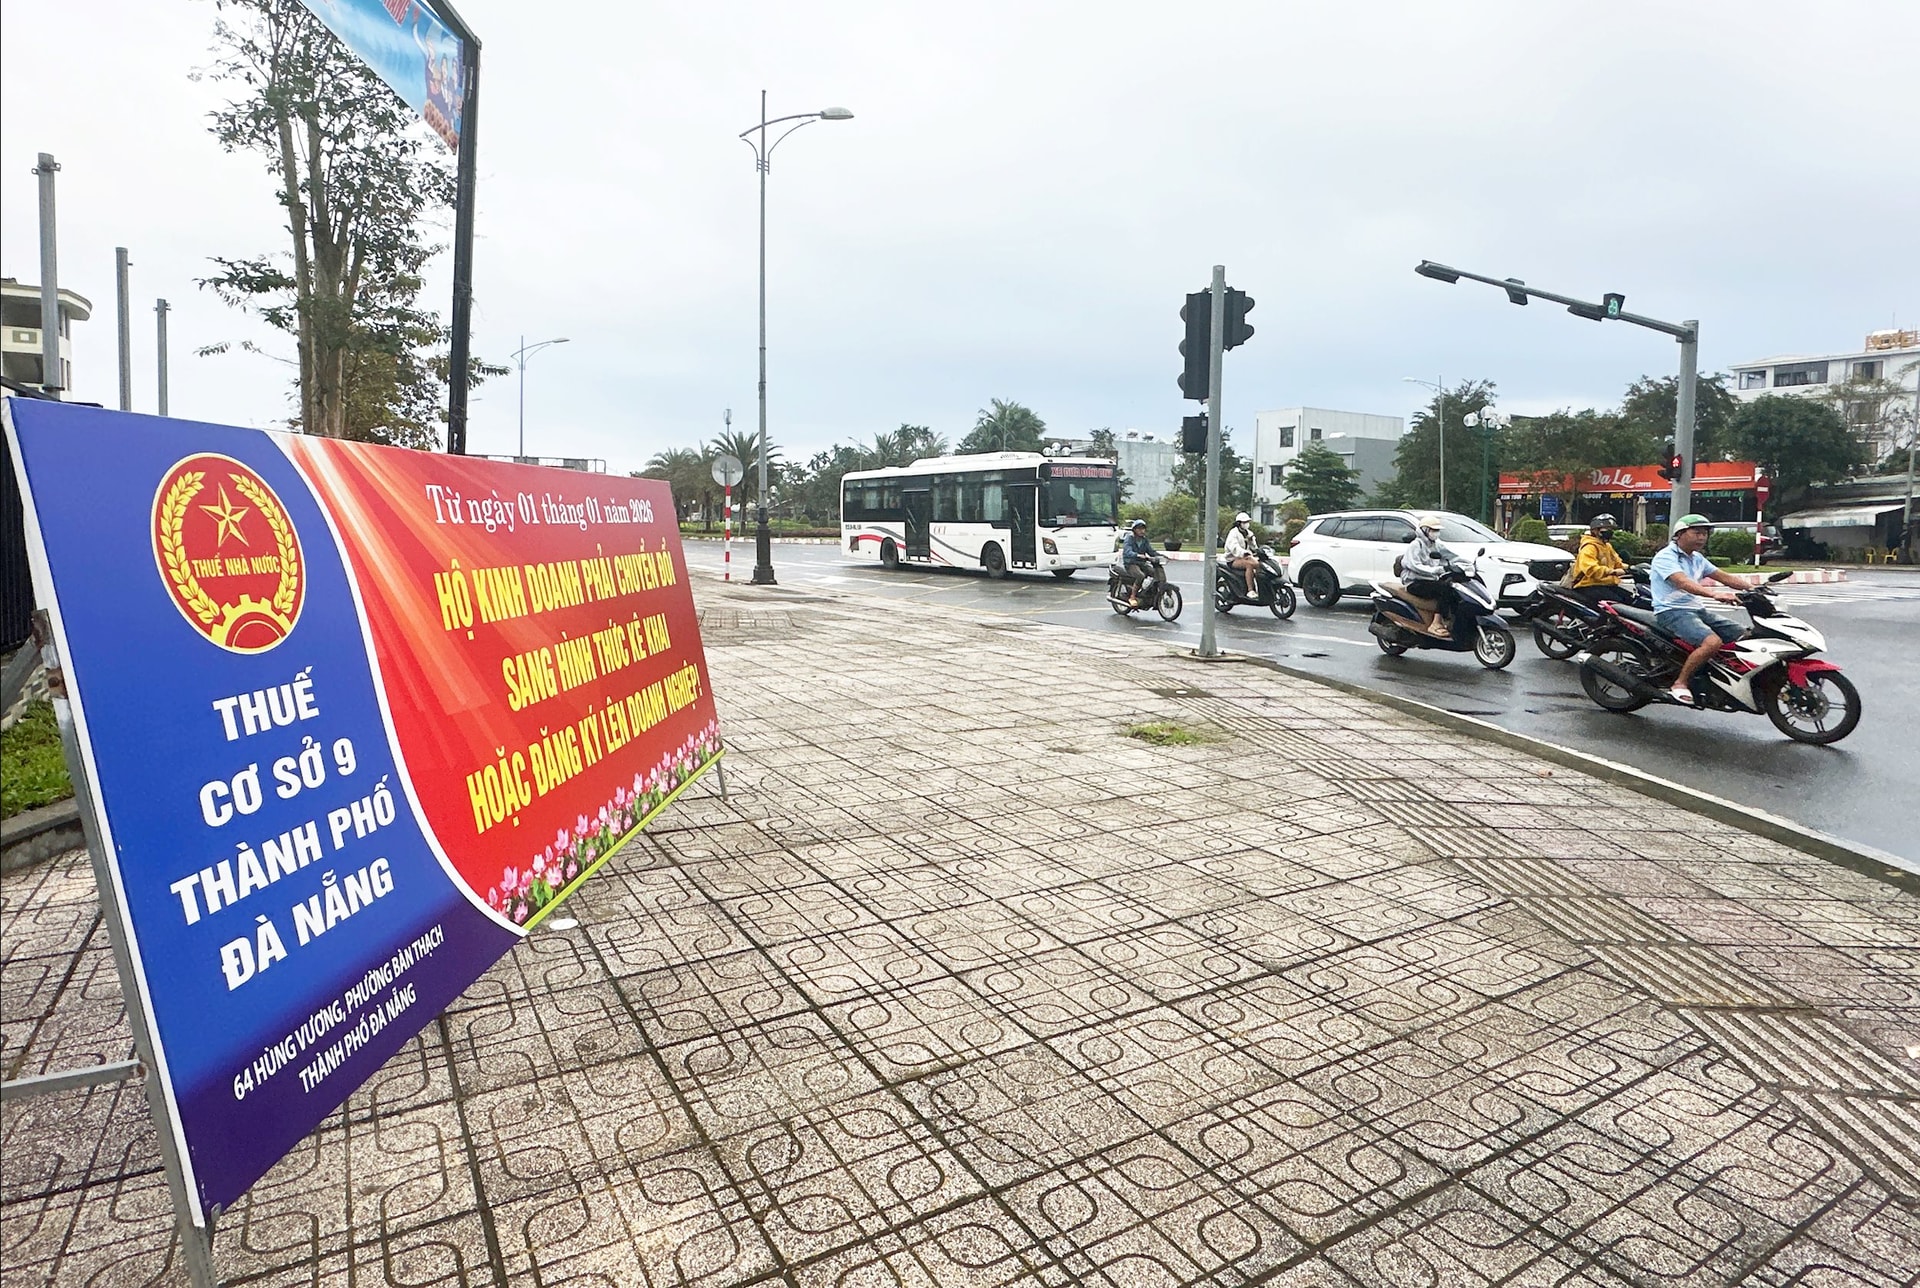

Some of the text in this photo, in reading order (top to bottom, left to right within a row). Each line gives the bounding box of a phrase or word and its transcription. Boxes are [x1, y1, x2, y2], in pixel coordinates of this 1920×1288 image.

[425, 484, 654, 533] Từ ngày 01 tháng 01 năm 2026
[1611, 468, 1634, 488] La
[191, 551, 281, 578] THUẾ NHÀ NƯỚC
[433, 536, 676, 640] HỘ KINH DOANH PHẢI CHUYỂN ĐỔI
[212, 665, 320, 742] THUẾ
[501, 612, 672, 712] SANG HÌNH THỨC KÊ KHAI
[198, 735, 357, 828] CƠ SỞ 9
[466, 659, 703, 834] HOẶC ĐĂNG KÝ LÊN DOANH NGHIỆP!
[169, 774, 397, 926] THÀNH PHỐ
[219, 856, 395, 992] ĐÀ NẴNG
[233, 923, 445, 1101] 64 HÙNG VƯƠNG, PHƯỜNG BÀN THẠCH
[298, 982, 417, 1094] THÀNH PHỐ ĐÀ NẴNG
